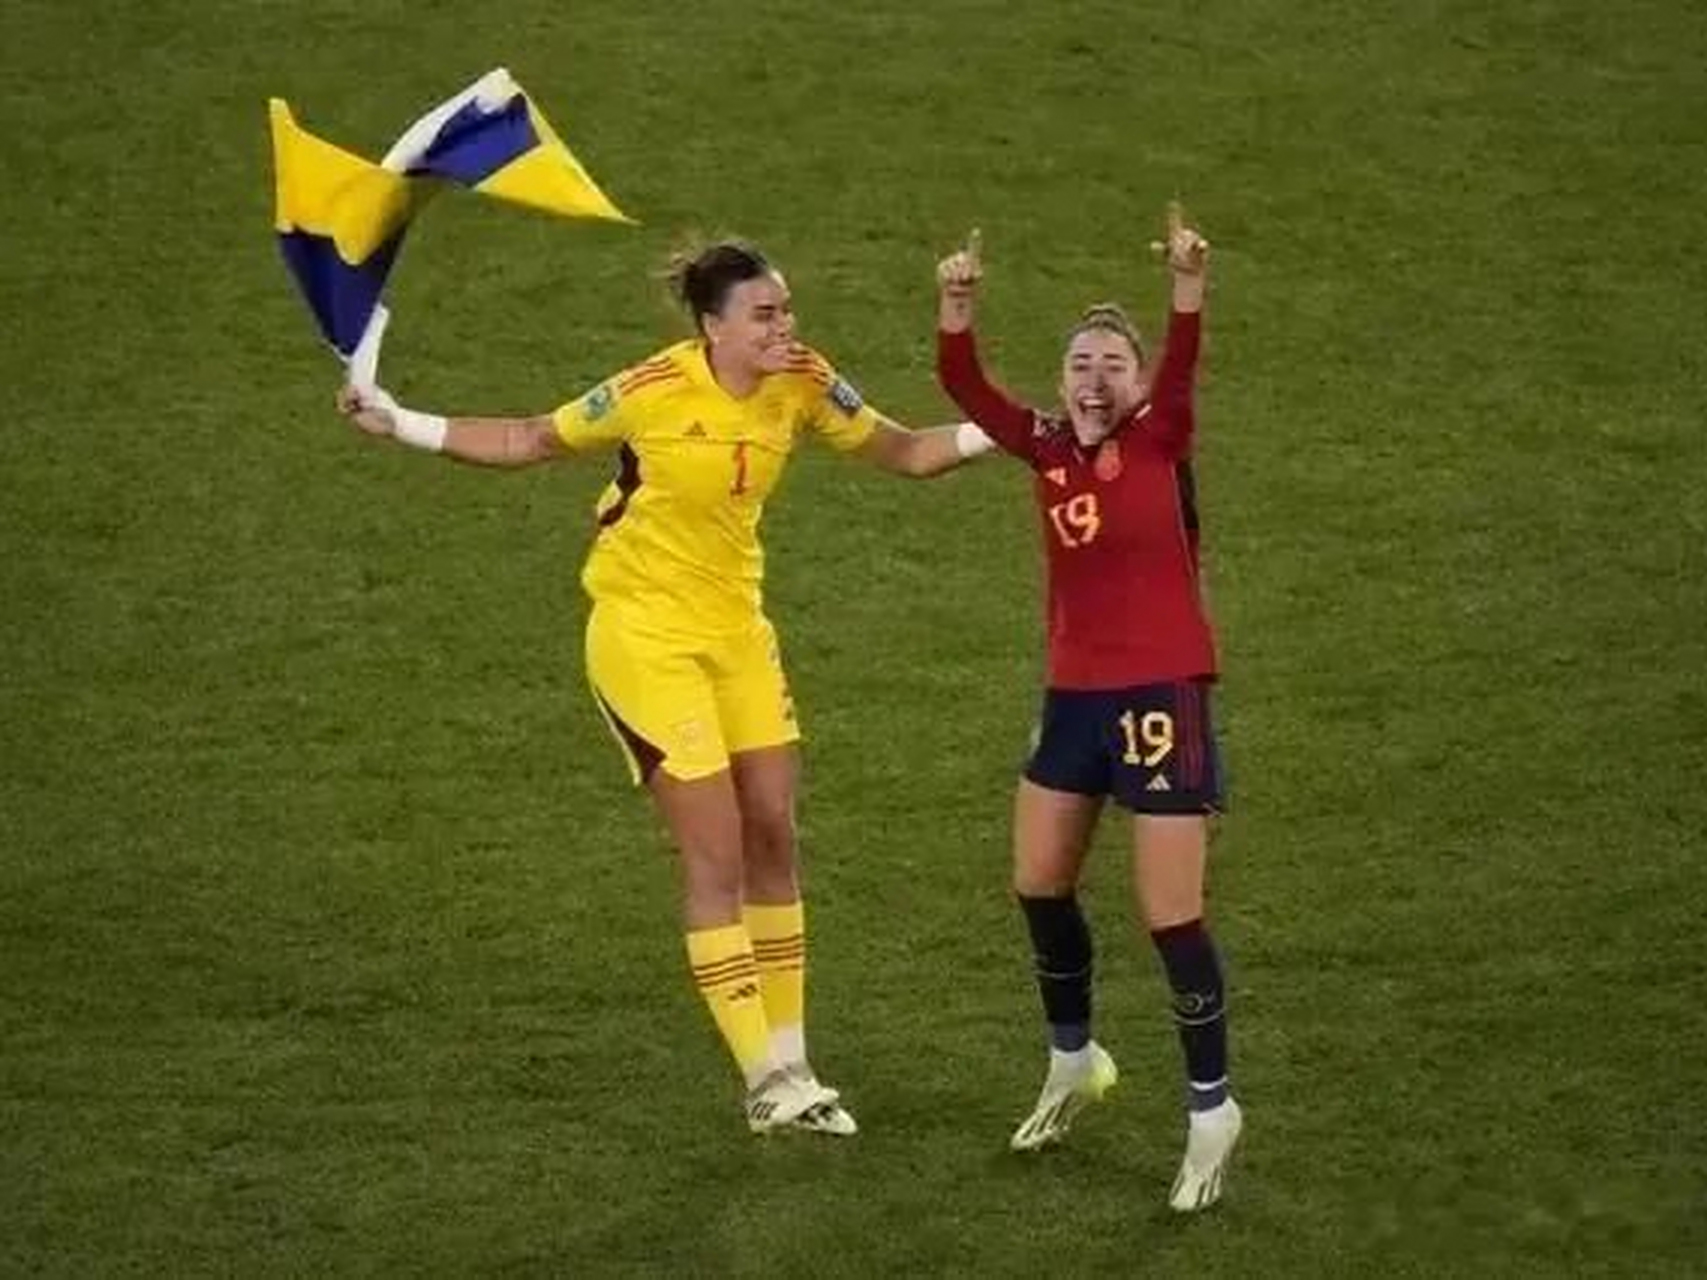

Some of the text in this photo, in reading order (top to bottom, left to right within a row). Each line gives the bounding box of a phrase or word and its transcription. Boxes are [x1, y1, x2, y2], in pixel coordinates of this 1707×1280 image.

[730, 441, 748, 496] 1
[1050, 493, 1099, 547] 19
[1119, 709, 1174, 767] 19
